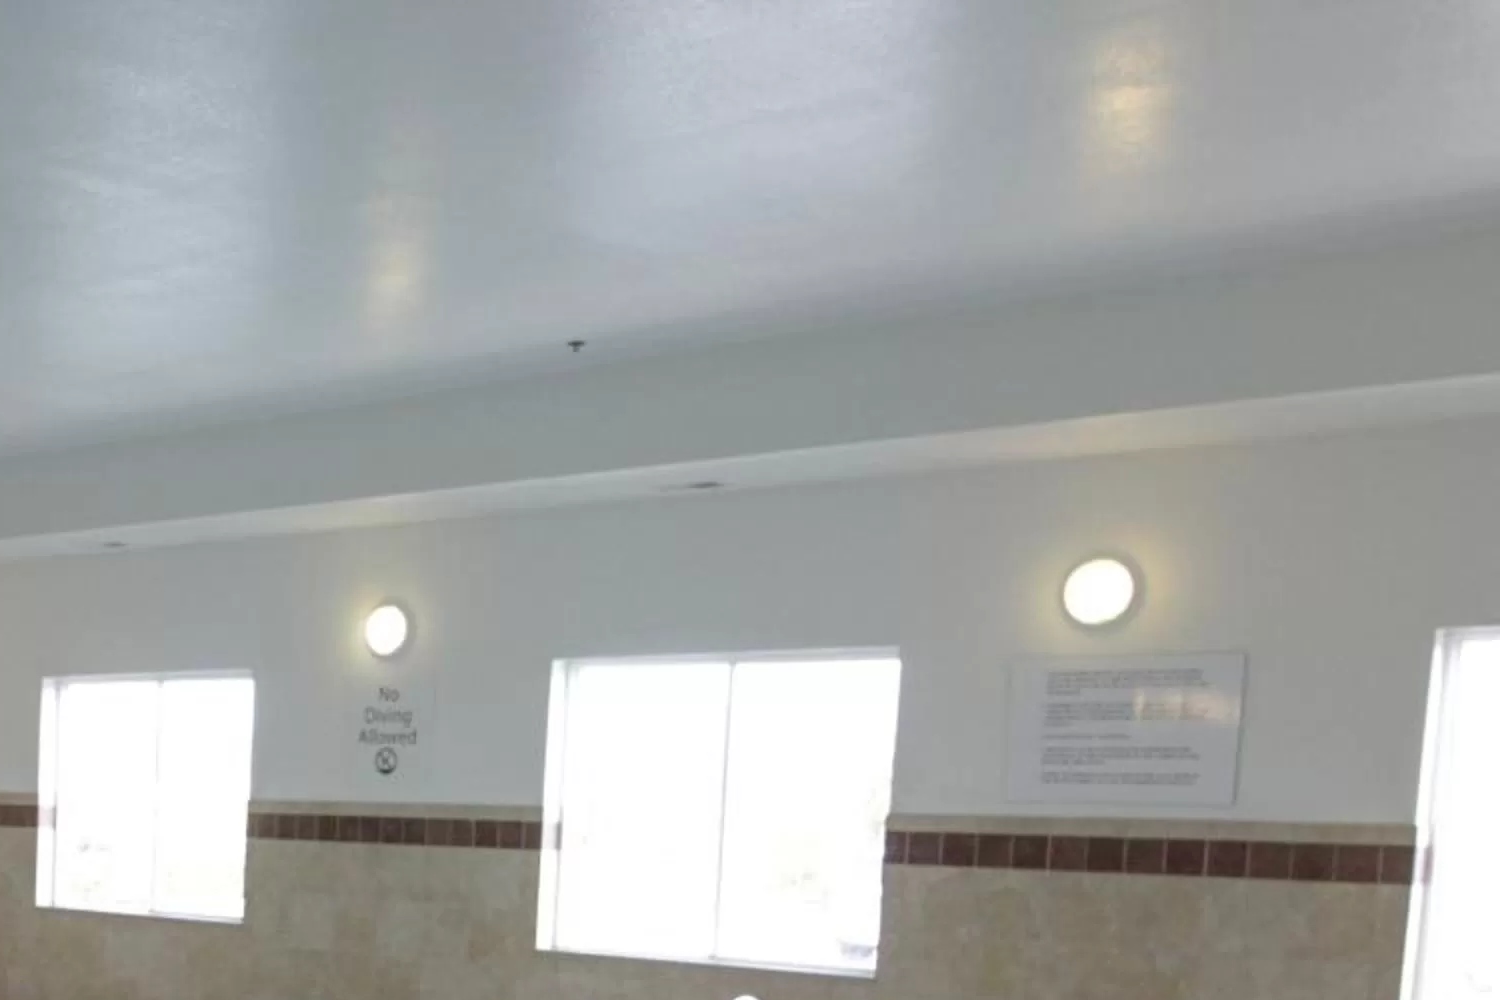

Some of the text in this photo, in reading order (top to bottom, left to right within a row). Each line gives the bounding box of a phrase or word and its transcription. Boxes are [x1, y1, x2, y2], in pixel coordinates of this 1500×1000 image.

[378, 687, 400, 703] No
[363, 705, 412, 728] Diving
[357, 726, 417, 746] Allowed
